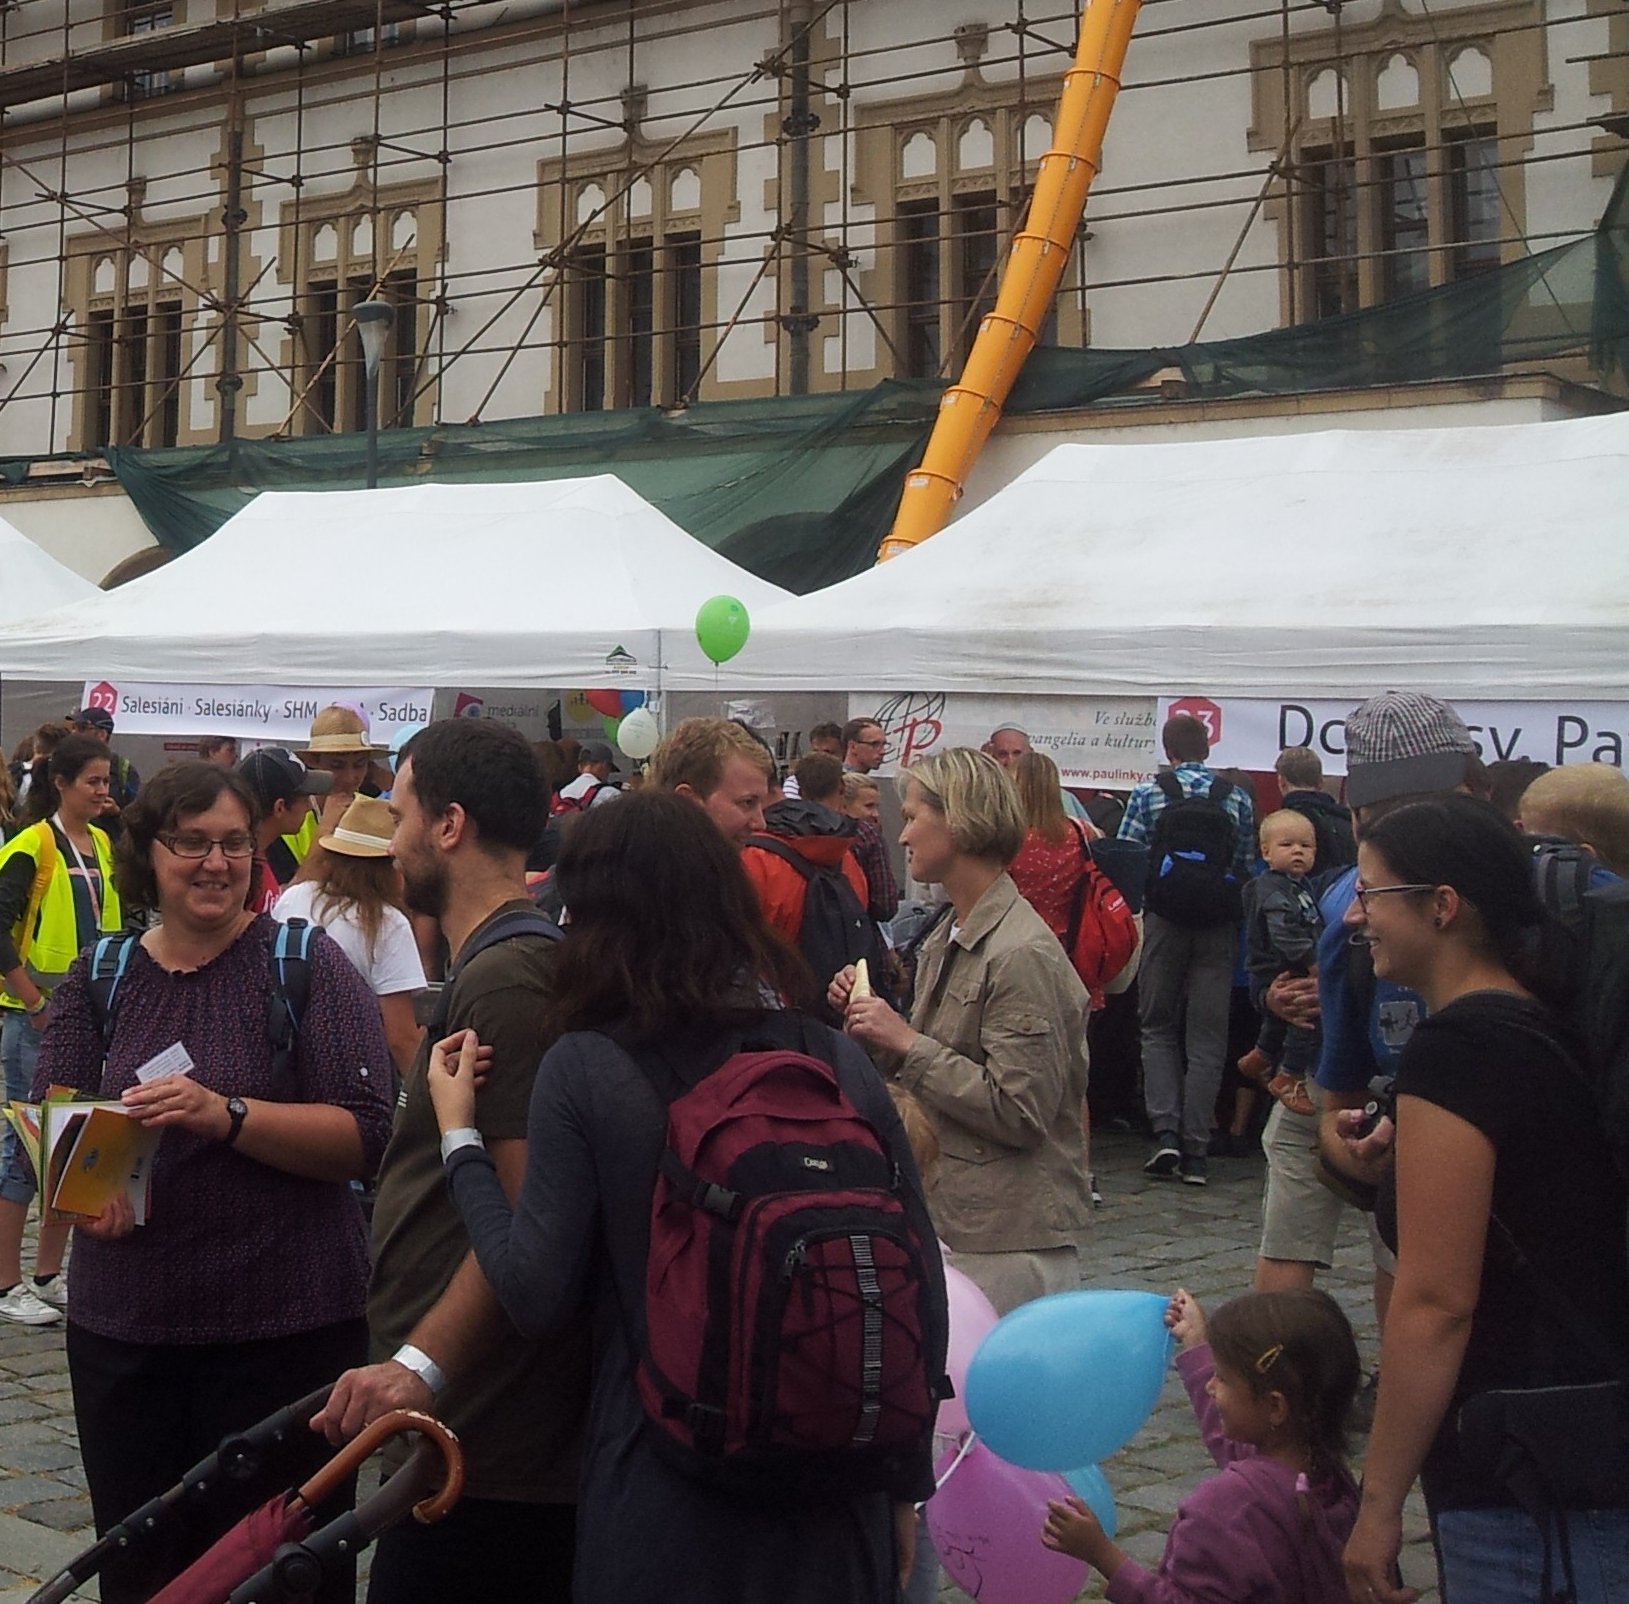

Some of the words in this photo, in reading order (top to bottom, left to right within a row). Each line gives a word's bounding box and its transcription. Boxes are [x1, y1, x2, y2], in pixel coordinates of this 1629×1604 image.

[92, 692, 114, 713] 22
[122, 696, 183, 715] Salesiáni
[195, 698, 271, 723] Salesiánky
[283, 700, 318, 719] SHM
[379, 702, 427, 722] Sadba
[1095, 711, 1109, 725] Ve
[1028, 732, 1086, 750] vangelia
[1091, 738, 1100, 747] a
[1061, 767, 1156, 783] www.paulinky.c
